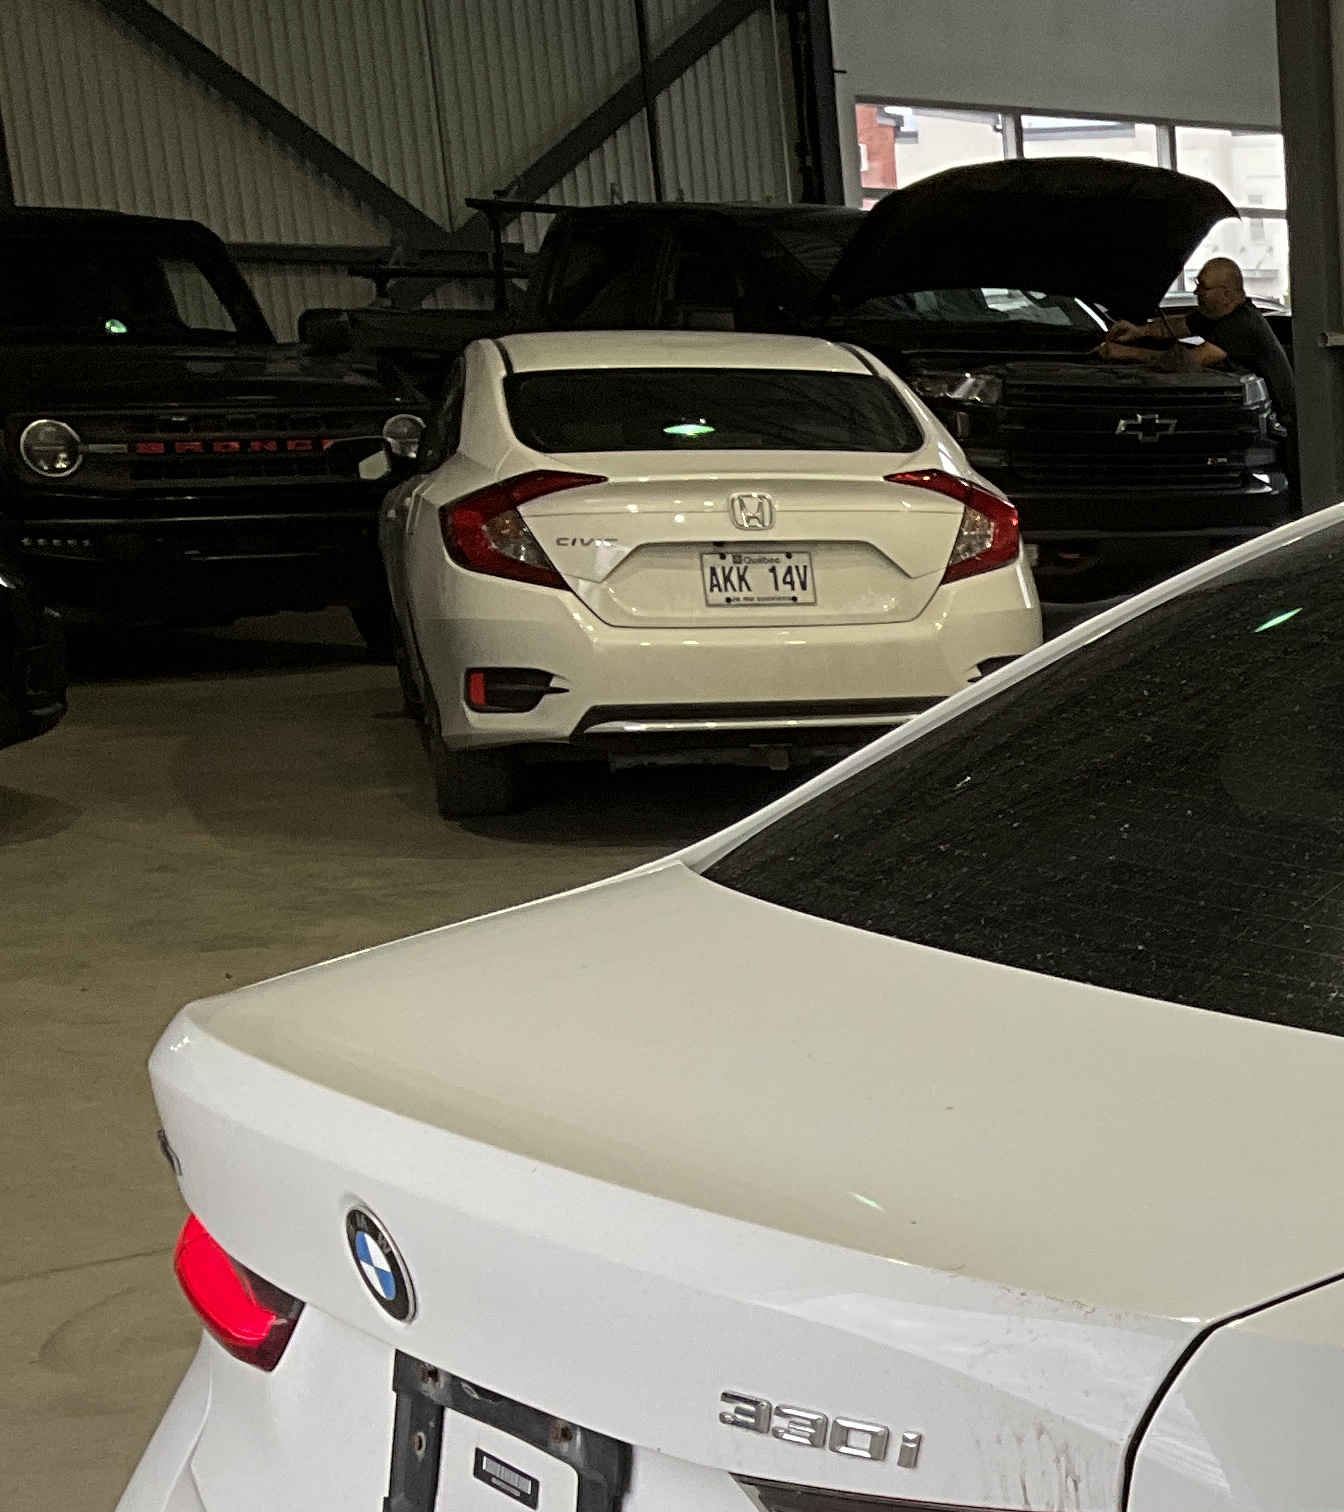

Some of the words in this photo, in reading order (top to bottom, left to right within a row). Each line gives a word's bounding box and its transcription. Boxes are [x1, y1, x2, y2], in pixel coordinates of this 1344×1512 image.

[709, 566, 752, 593] AKK
[768, 565, 808, 592] 14V
[718, 1389, 923, 1469] 330i
